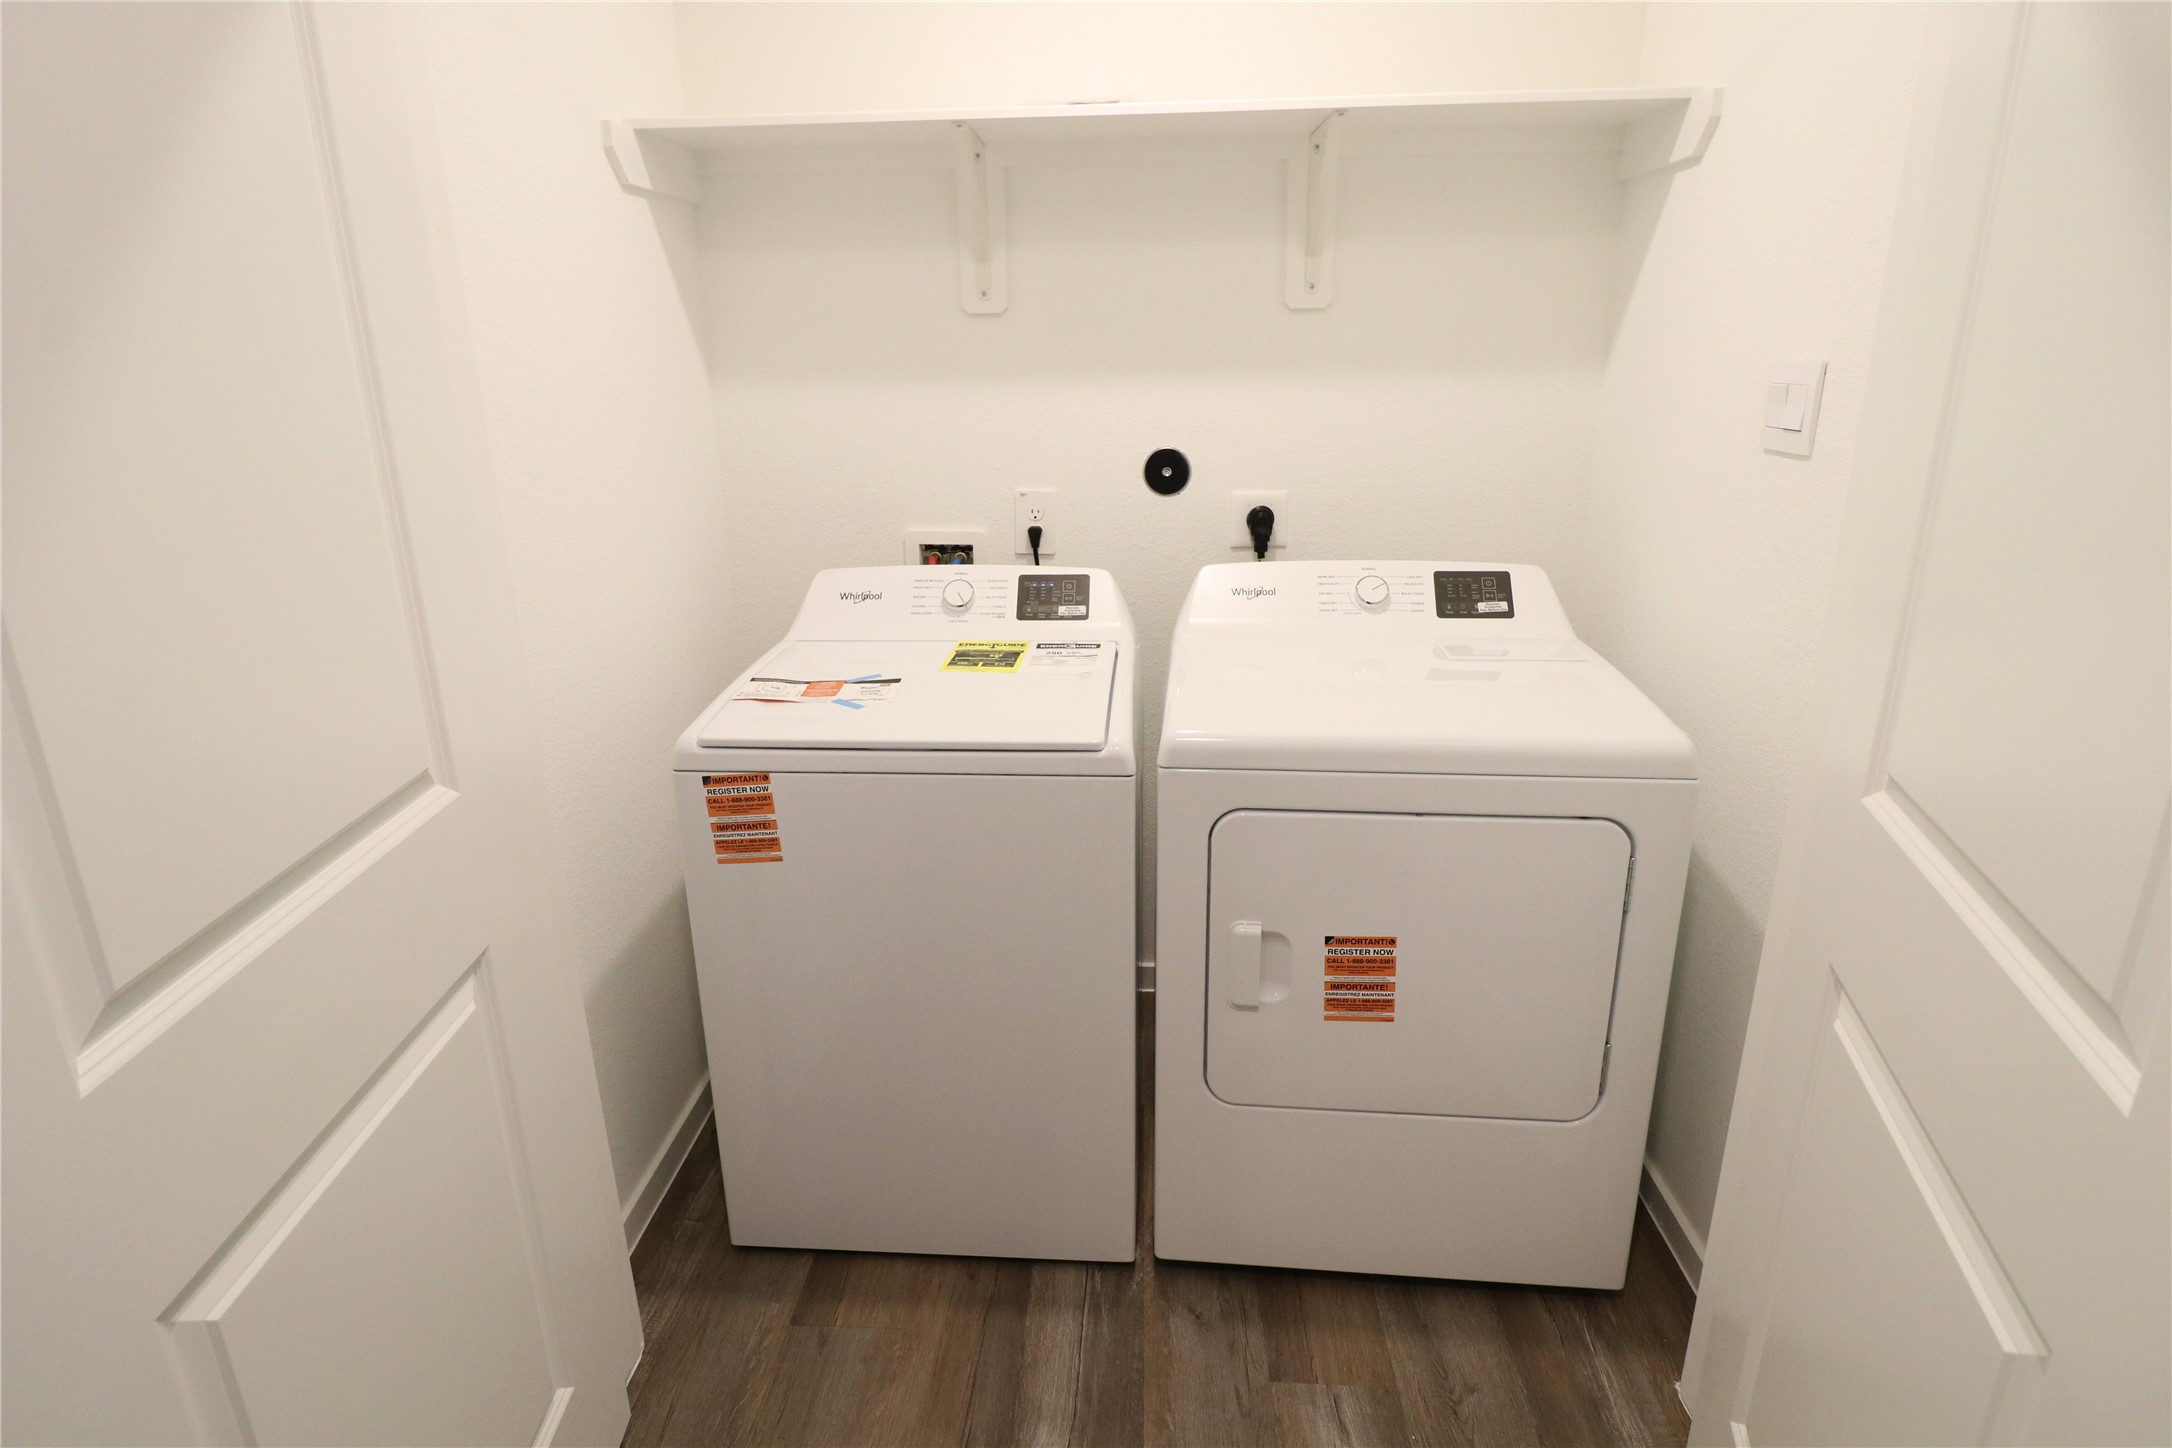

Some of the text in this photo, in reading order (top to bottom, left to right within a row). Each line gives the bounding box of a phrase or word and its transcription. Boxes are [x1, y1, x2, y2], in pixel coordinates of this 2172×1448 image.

[840, 591, 882, 604] Whirlpool
[1231, 586, 1276, 600] Whirlpool
[712, 775, 762, 785] IMPORTANT!
[707, 785, 769, 795] REGISTER NOW
[716, 823, 771, 832] IMPORTANTE!
[1327, 948, 1371, 956] REGISTER
[1330, 983, 1388, 991] IMPORTANTE!
